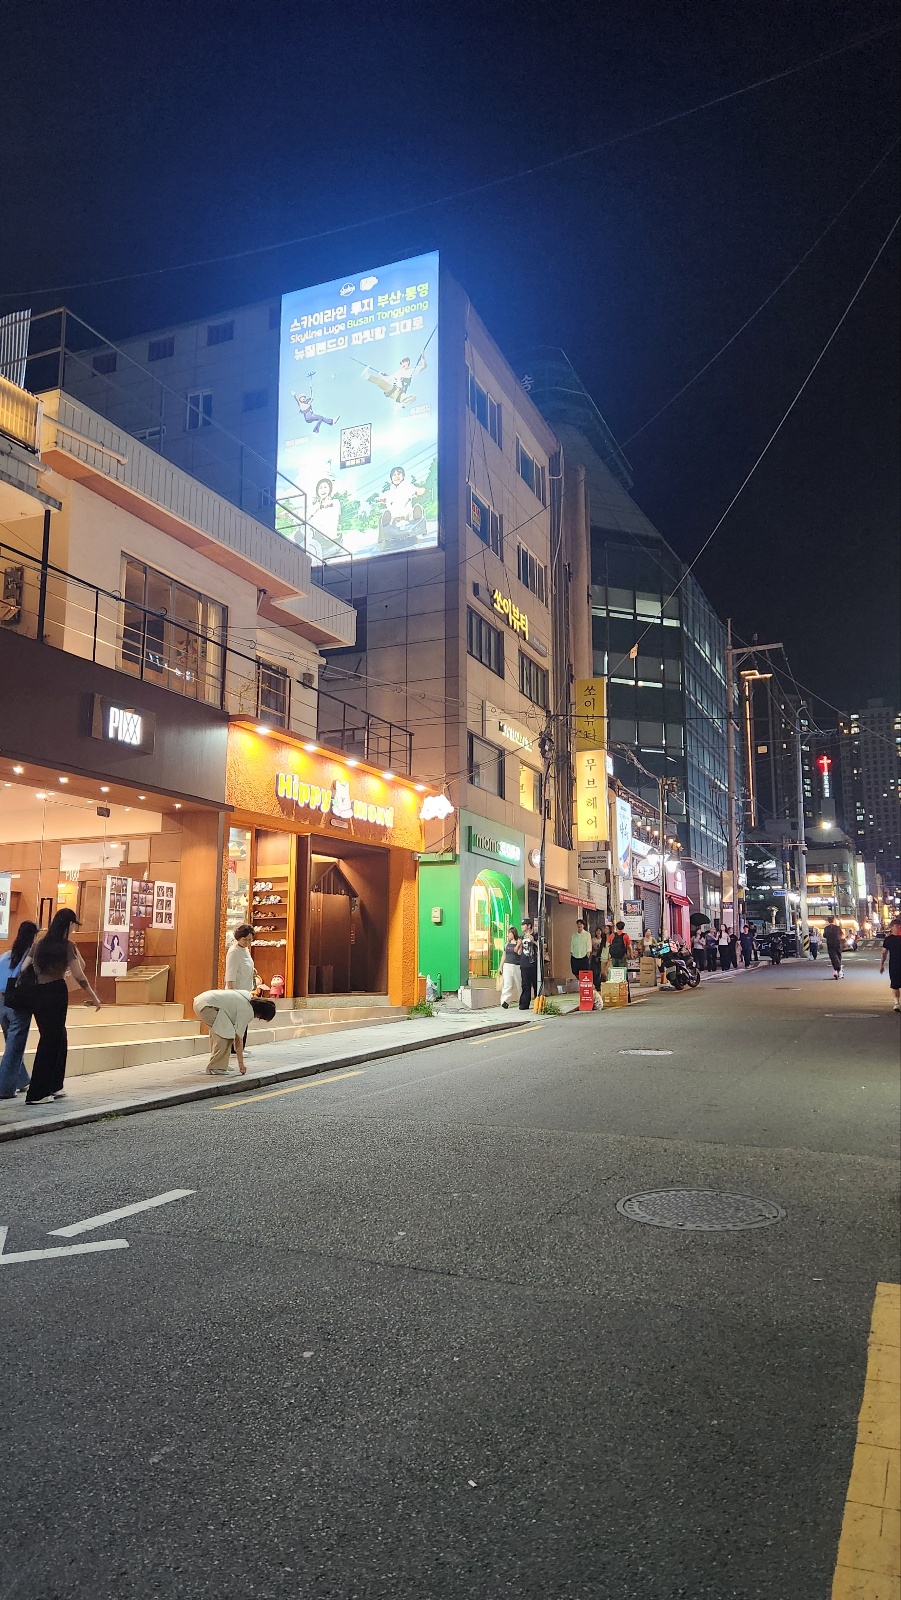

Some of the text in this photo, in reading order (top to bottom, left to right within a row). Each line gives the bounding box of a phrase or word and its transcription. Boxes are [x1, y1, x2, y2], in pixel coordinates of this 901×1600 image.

[289, 305, 347, 332] 스카이라인
[350, 297, 374, 316] 루지
[377, 281, 429, 307] 부산·통영
[289, 299, 429, 345] Skyline Luge Busan Tongyeong
[293, 336, 348, 361] 뉴질랜드의
[388, 315, 424, 337] 그대로
[493, 588, 528, 641] 쏘이뷰티
[583, 685, 597, 741] 쏘이뷰티
[276, 772, 332, 813] Hippy
[584, 758, 598, 829] 무브헤어
